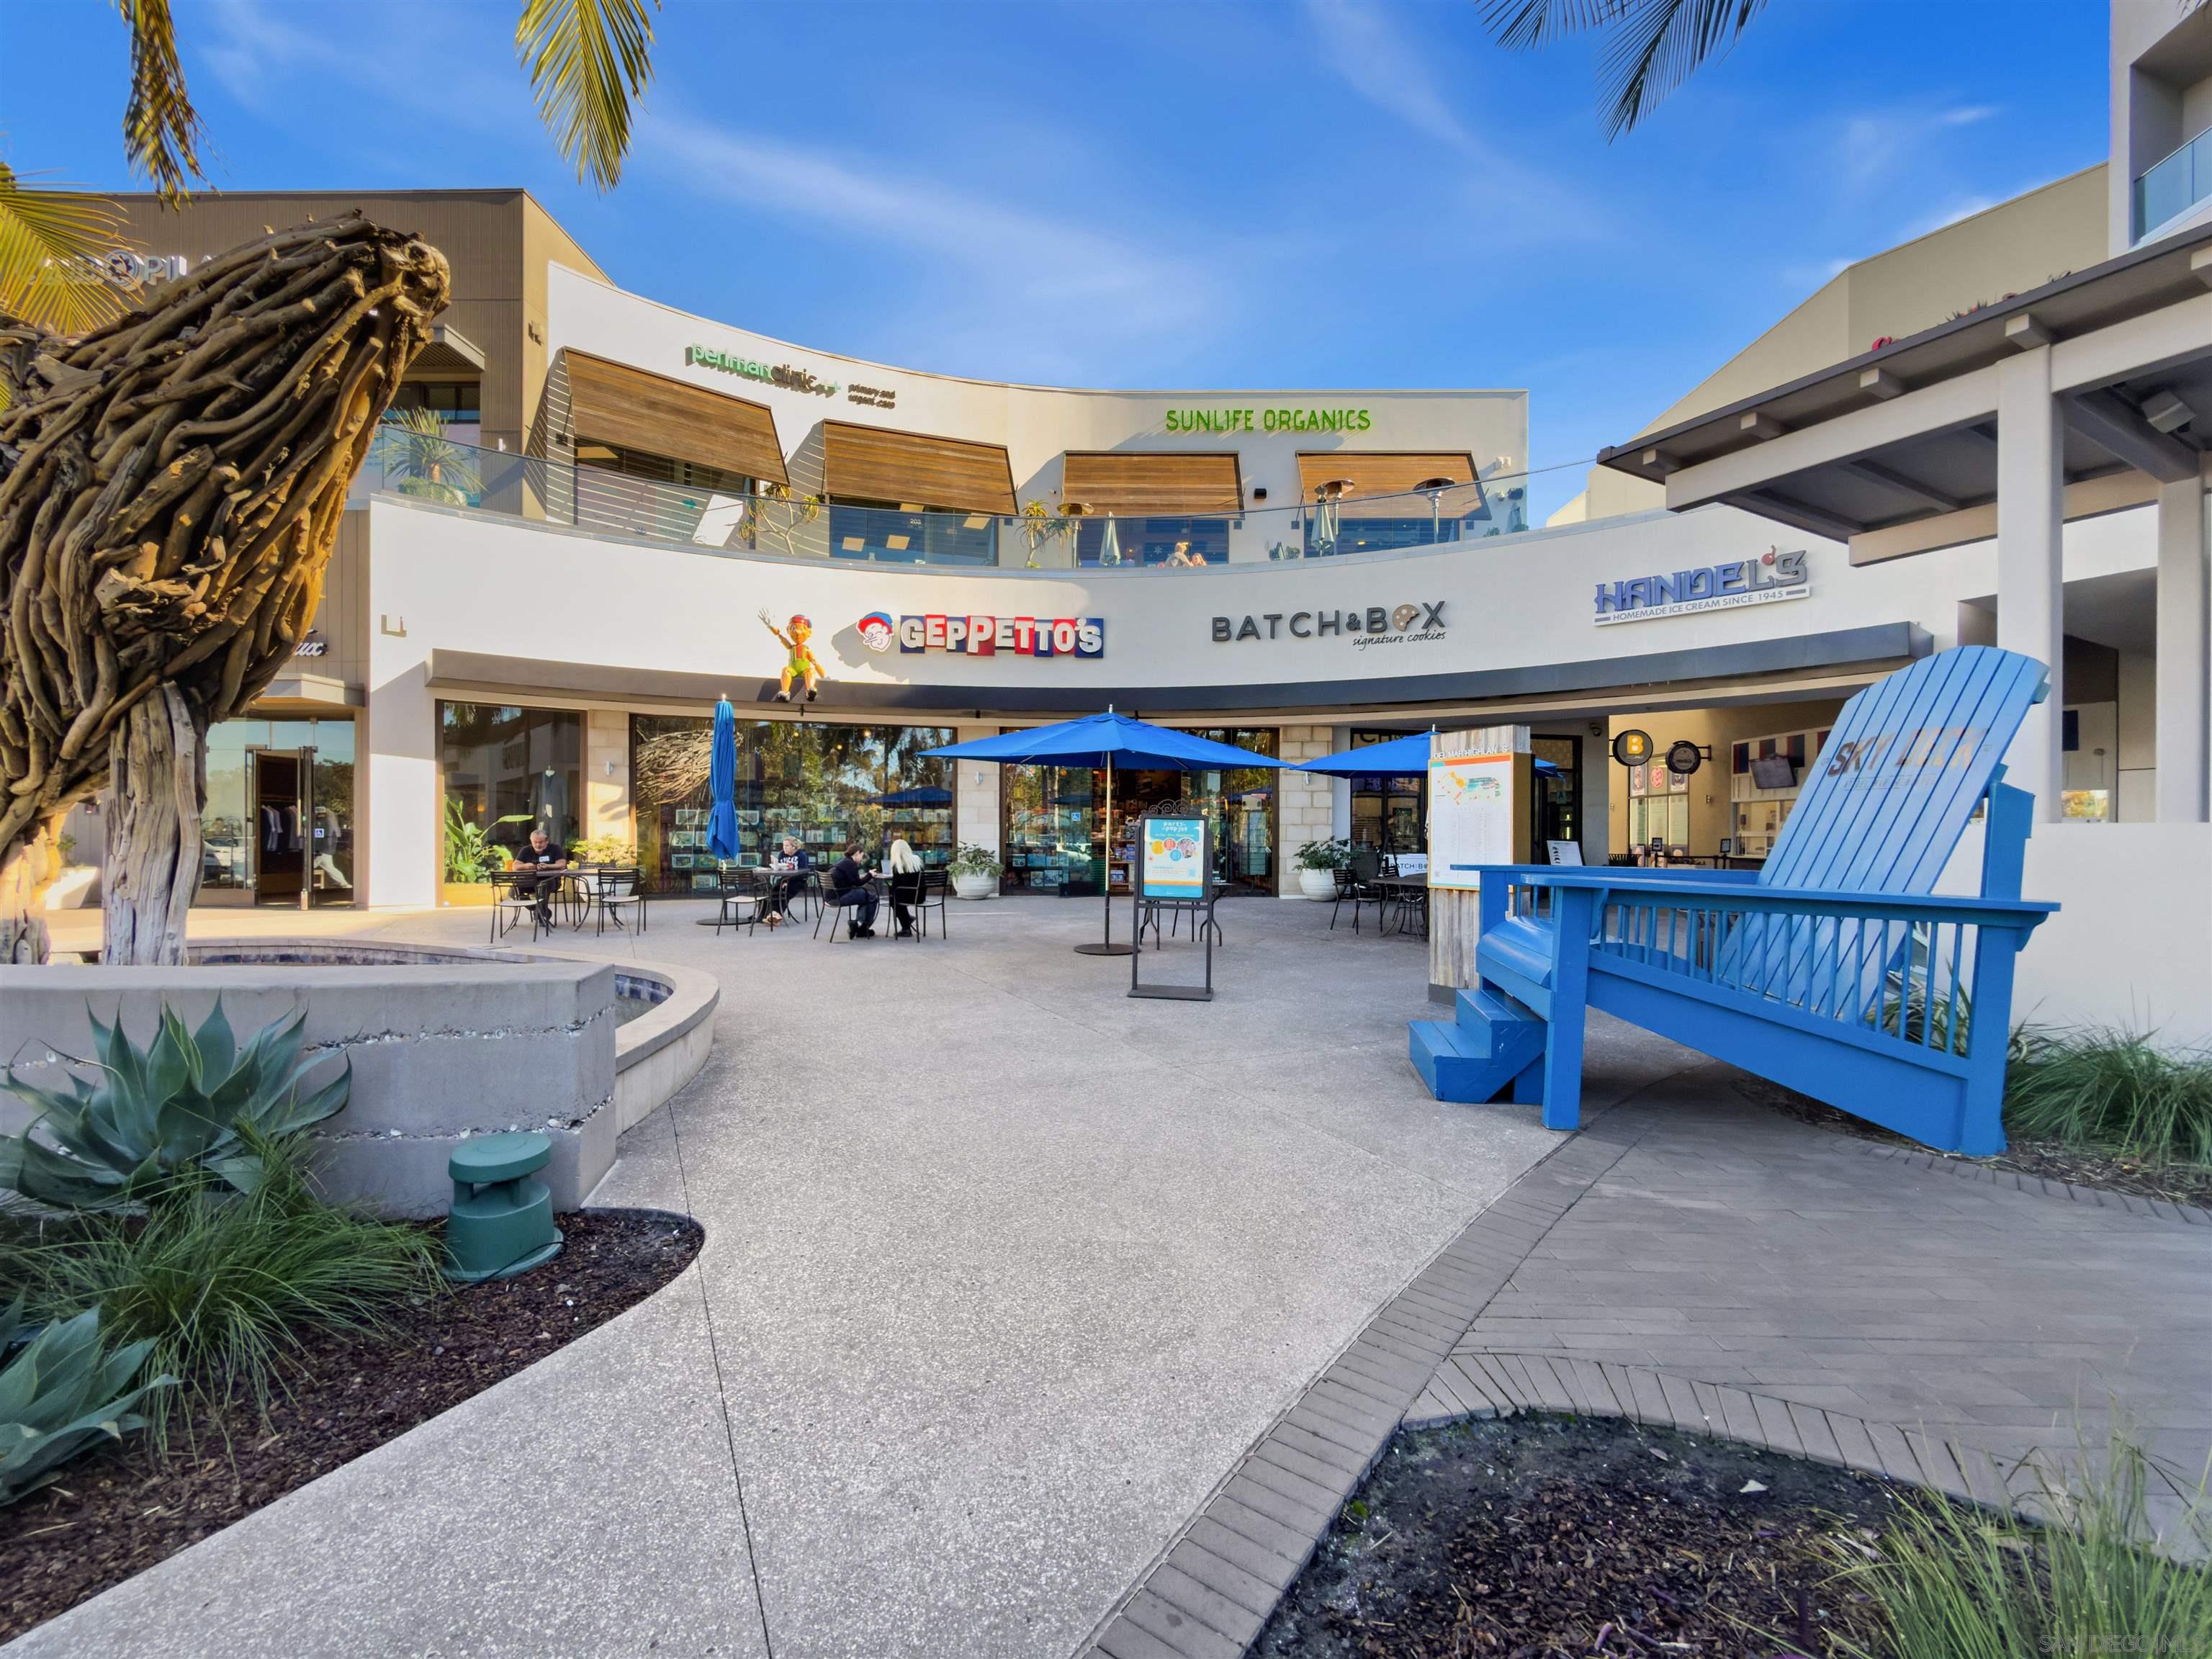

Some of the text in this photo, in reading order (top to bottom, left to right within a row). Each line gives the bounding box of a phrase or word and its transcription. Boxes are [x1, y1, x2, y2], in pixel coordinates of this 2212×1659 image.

[1165, 409, 1371, 431] SUNLIFE ORGANICS
[1613, 607, 1667, 621] HOMEMADE
[1685, 601, 1720, 611] CREAM
[1722, 595, 1753, 606] SINCE
[1758, 591, 1784, 601] 1945
[900, 615, 1103, 655] GEPPETTO'S
[1353, 629, 1446, 651] signature cookies
[1627, 734, 1644, 755] B
[1827, 733, 1894, 777] SKY
